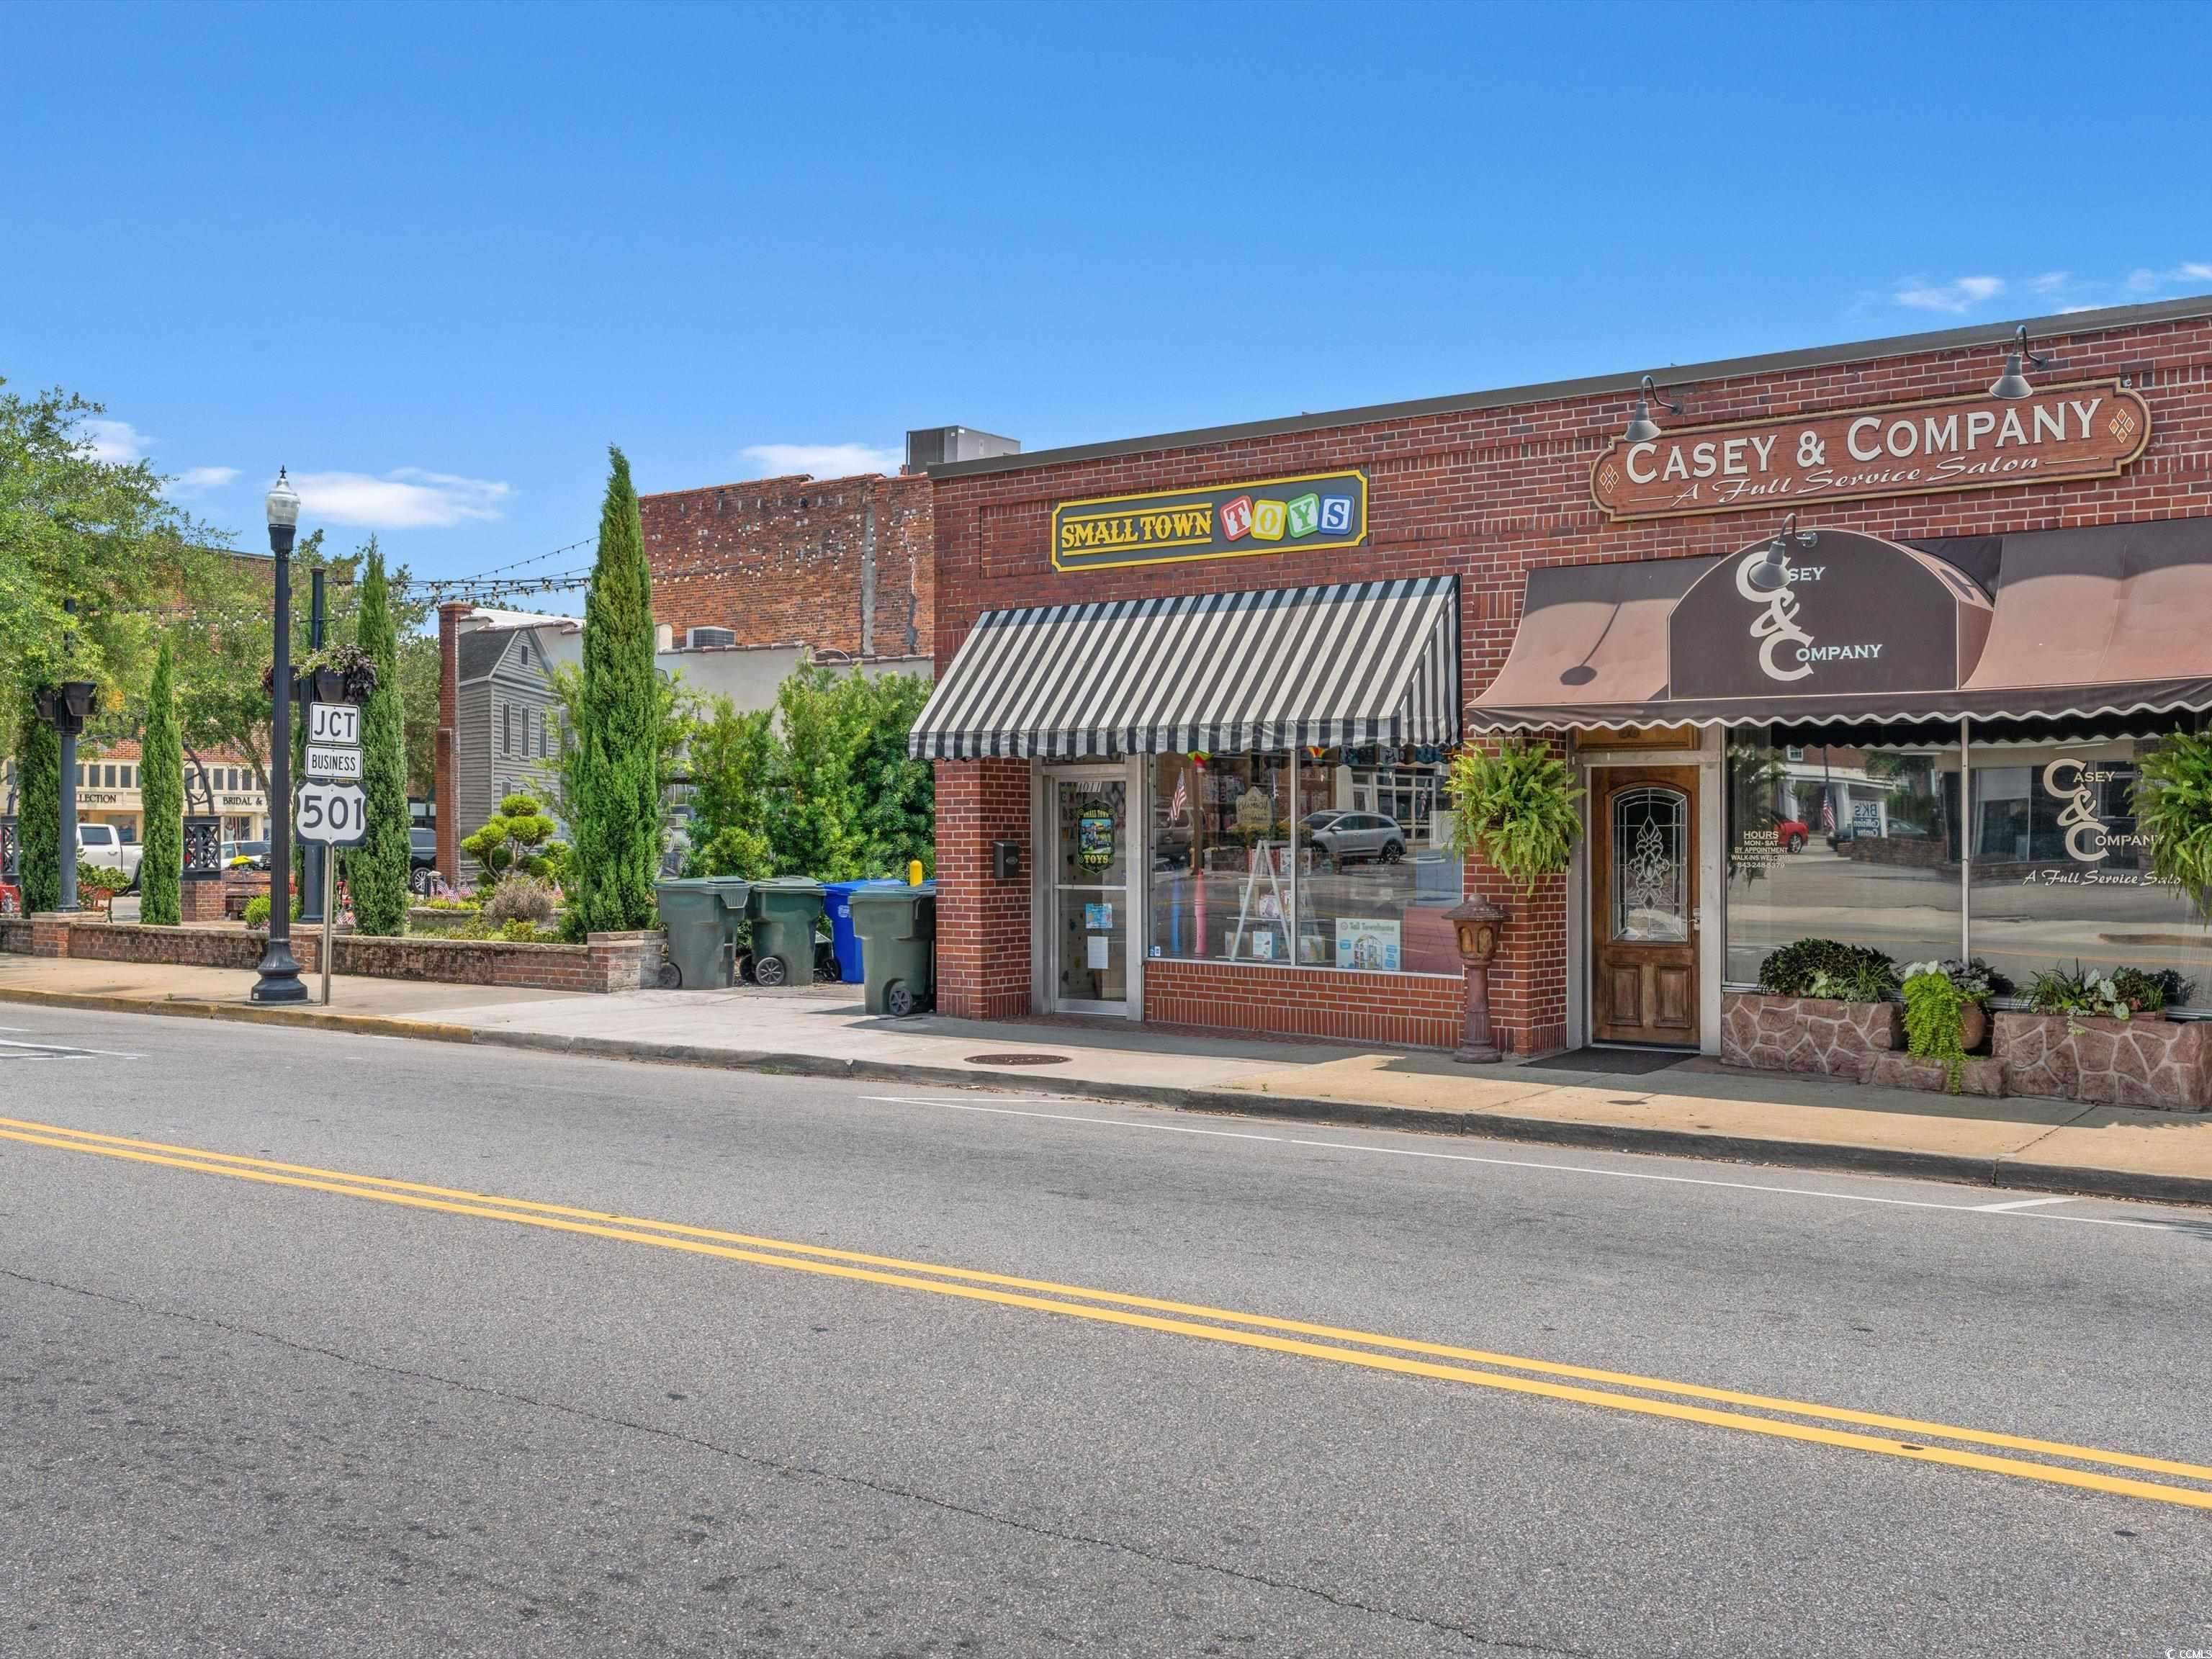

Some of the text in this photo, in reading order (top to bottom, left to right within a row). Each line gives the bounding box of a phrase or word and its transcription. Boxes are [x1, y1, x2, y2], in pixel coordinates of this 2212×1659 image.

[1626, 397, 2103, 485] CASEY & COMPANY
[1671, 456, 2038, 508] A Full Service Salon
[1061, 498, 1349, 548] SMALL TOWN TOYS
[1735, 551, 1827, 603] CSEY
[1750, 590, 1802, 638] &
[1758, 629, 1884, 681] COMPANY
[314, 710, 356, 738] JCT
[312, 754, 356, 772] BUSINESS
[2042, 757, 2116, 799] CASEY
[76, 793, 117, 803] LECTION
[222, 796, 253, 806] BRIDAL
[302, 794, 361, 830] 501
[2056, 789, 2099, 827] &
[1743, 830, 1779, 840] HOURS
[1083, 854, 1109, 864] TOYS
[2022, 869, 2037, 886] A
[2041, 869, 2080, 886] Full
[2080, 869, 2138, 886] Service
